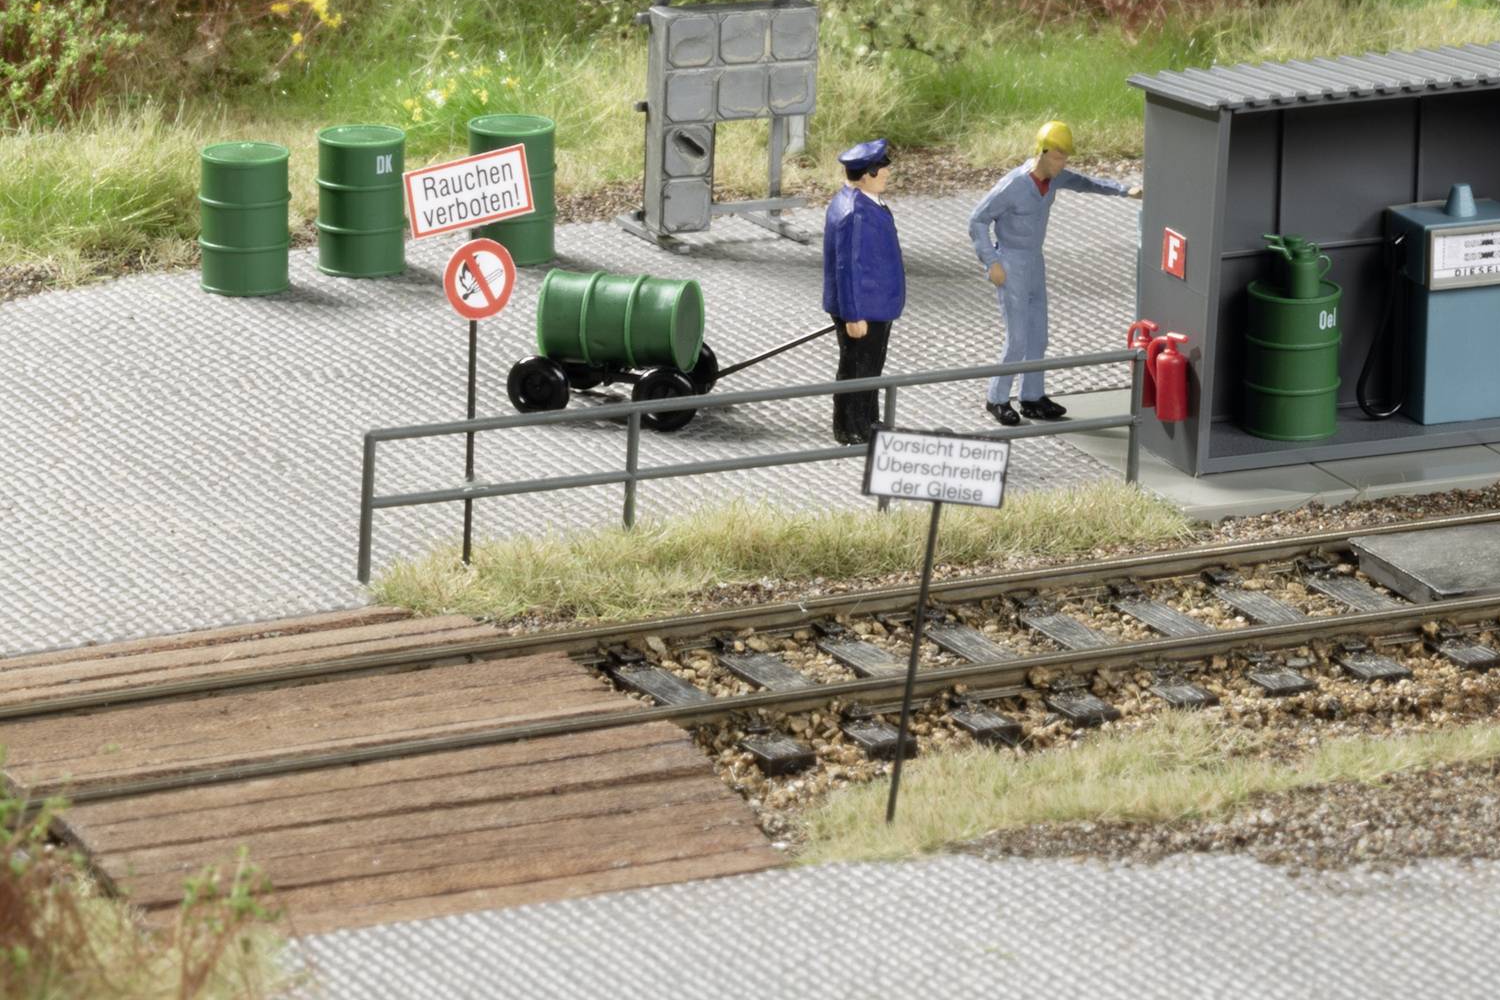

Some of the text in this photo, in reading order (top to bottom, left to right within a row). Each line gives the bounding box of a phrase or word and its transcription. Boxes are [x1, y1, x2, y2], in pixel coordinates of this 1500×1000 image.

[376, 153, 393, 175] DK
[422, 163, 513, 200] Rauchen
[423, 183, 520, 227] verboten!
[1168, 235, 1180, 268] F
[1319, 307, 1336, 330] Oel
[881, 435, 1003, 461] Vorsicht beim
[876, 451, 1003, 483] Überschreiten
[891, 478, 983, 501] der Gleise
